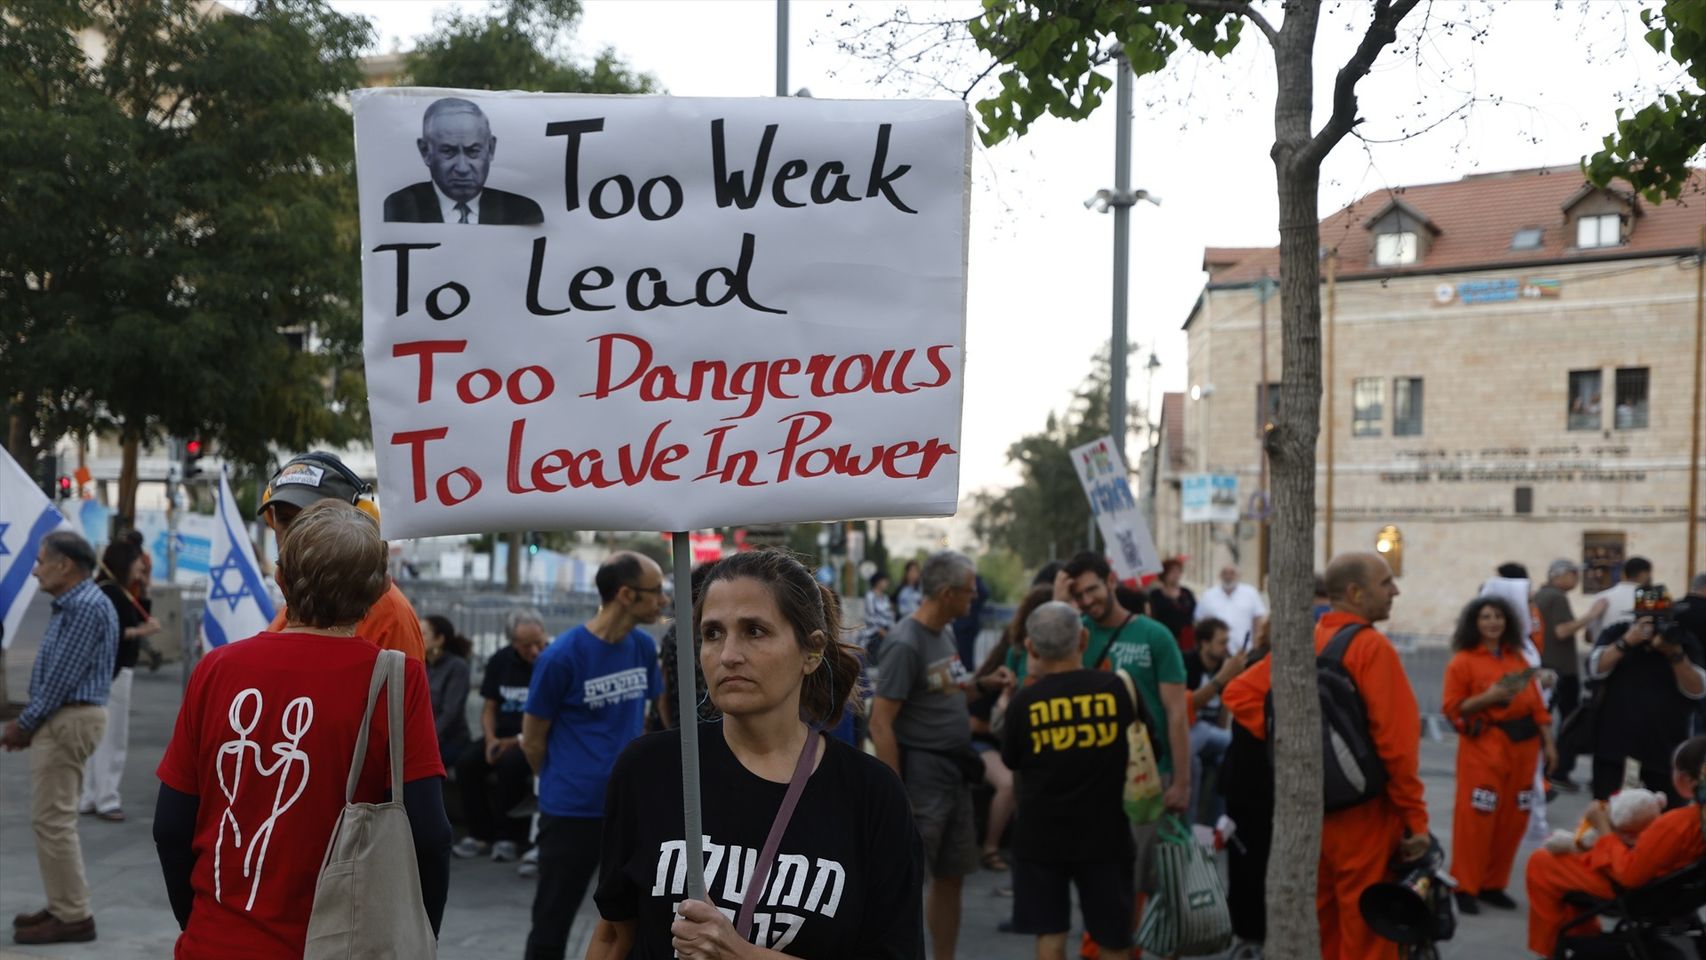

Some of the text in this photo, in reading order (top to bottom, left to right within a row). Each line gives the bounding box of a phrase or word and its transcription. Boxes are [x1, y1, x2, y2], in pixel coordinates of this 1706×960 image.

[545, 117, 919, 221] Too Weak
[372, 242, 471, 321] To
[393, 333, 953, 421] Too Dangerous
[278, 474, 318, 485] Colorado
[391, 427, 482, 507] To
[692, 424, 768, 487] In
[755, 411, 957, 483] Power
[1029, 692, 1117, 726] הדחה
[1030, 722, 1118, 753] עכשיו
[651, 834, 846, 919] ממשלת
